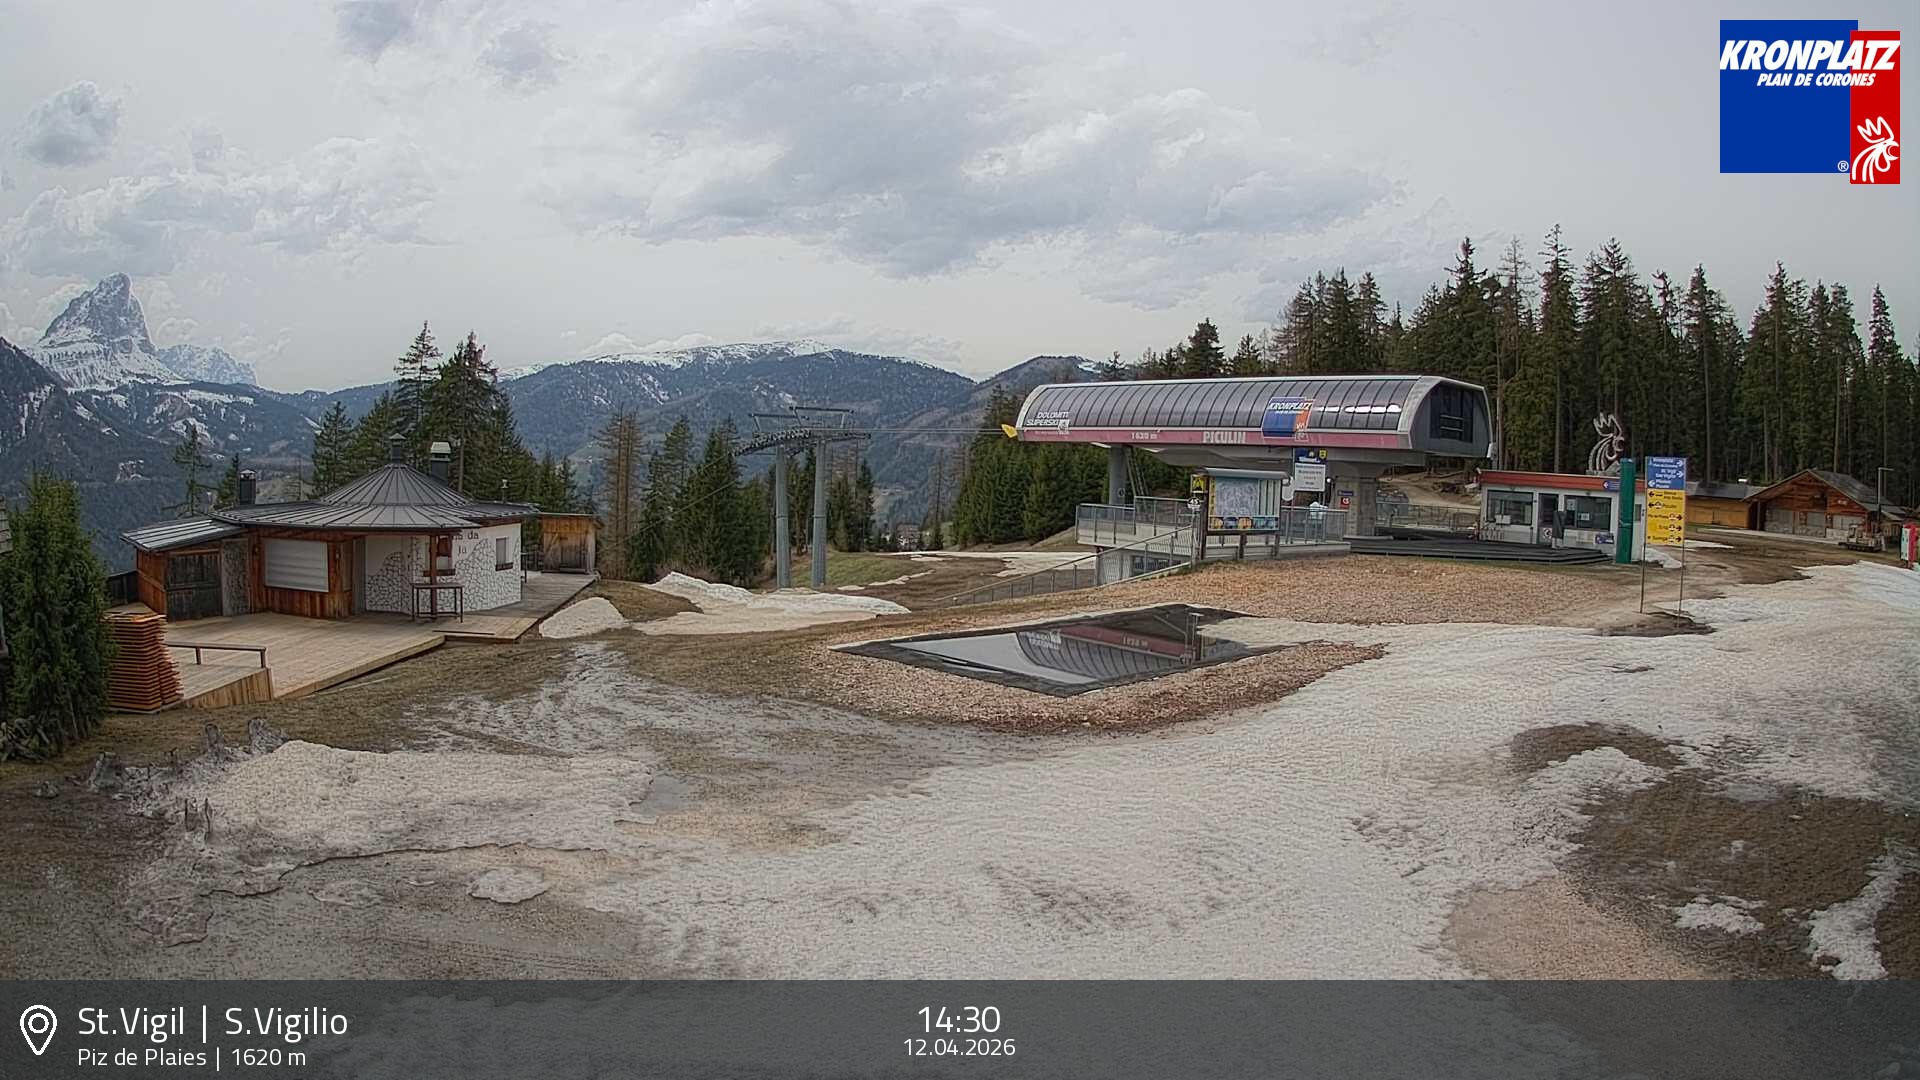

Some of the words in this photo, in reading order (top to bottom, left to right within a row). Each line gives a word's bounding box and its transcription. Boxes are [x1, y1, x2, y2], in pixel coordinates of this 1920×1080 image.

[1269, 402, 1312, 410] KRONPLATZ
[1131, 432, 1149, 440] 1620
[1202, 431, 1246, 444] PICULIN
